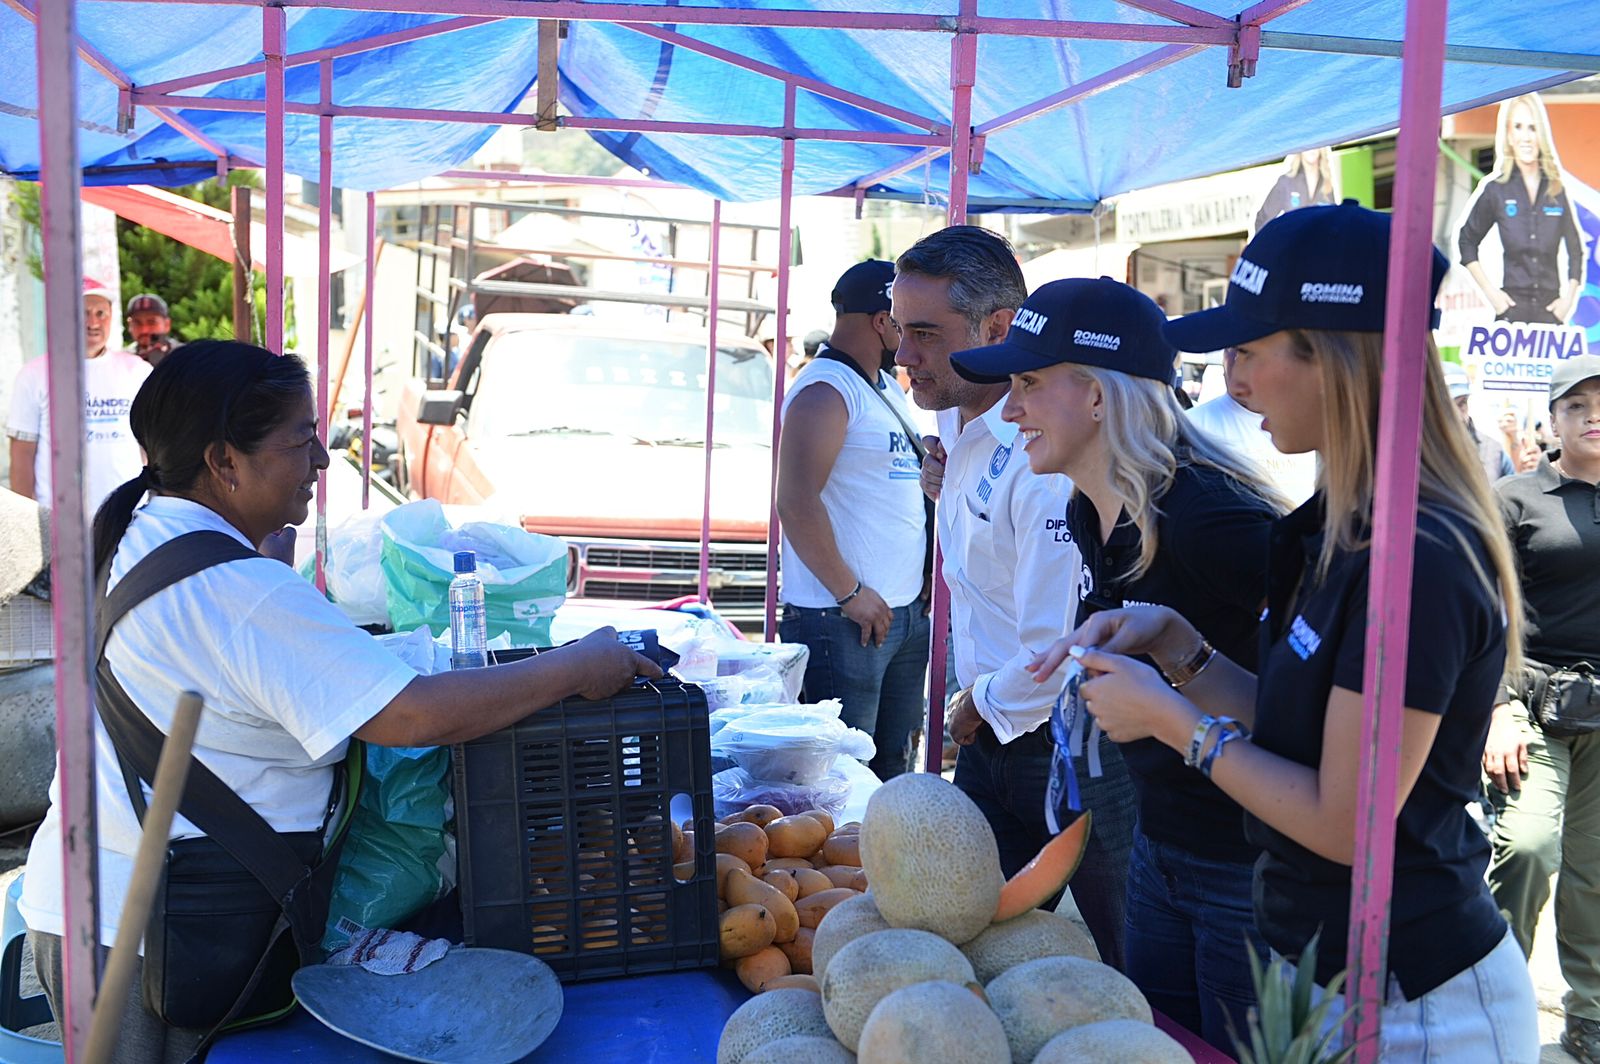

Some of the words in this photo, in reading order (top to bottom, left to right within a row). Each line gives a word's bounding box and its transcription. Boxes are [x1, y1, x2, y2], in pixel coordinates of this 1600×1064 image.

[1300, 282, 1363, 298] ROMINA
[1073, 329, 1121, 345] ROMINA
[1073, 338, 1119, 351] CONTRERAS
[1467, 326, 1583, 359] ROMINA
[1484, 361, 1553, 377] CONTRER
[1046, 519, 1067, 531] DIP
[1055, 532, 1073, 543] LO
